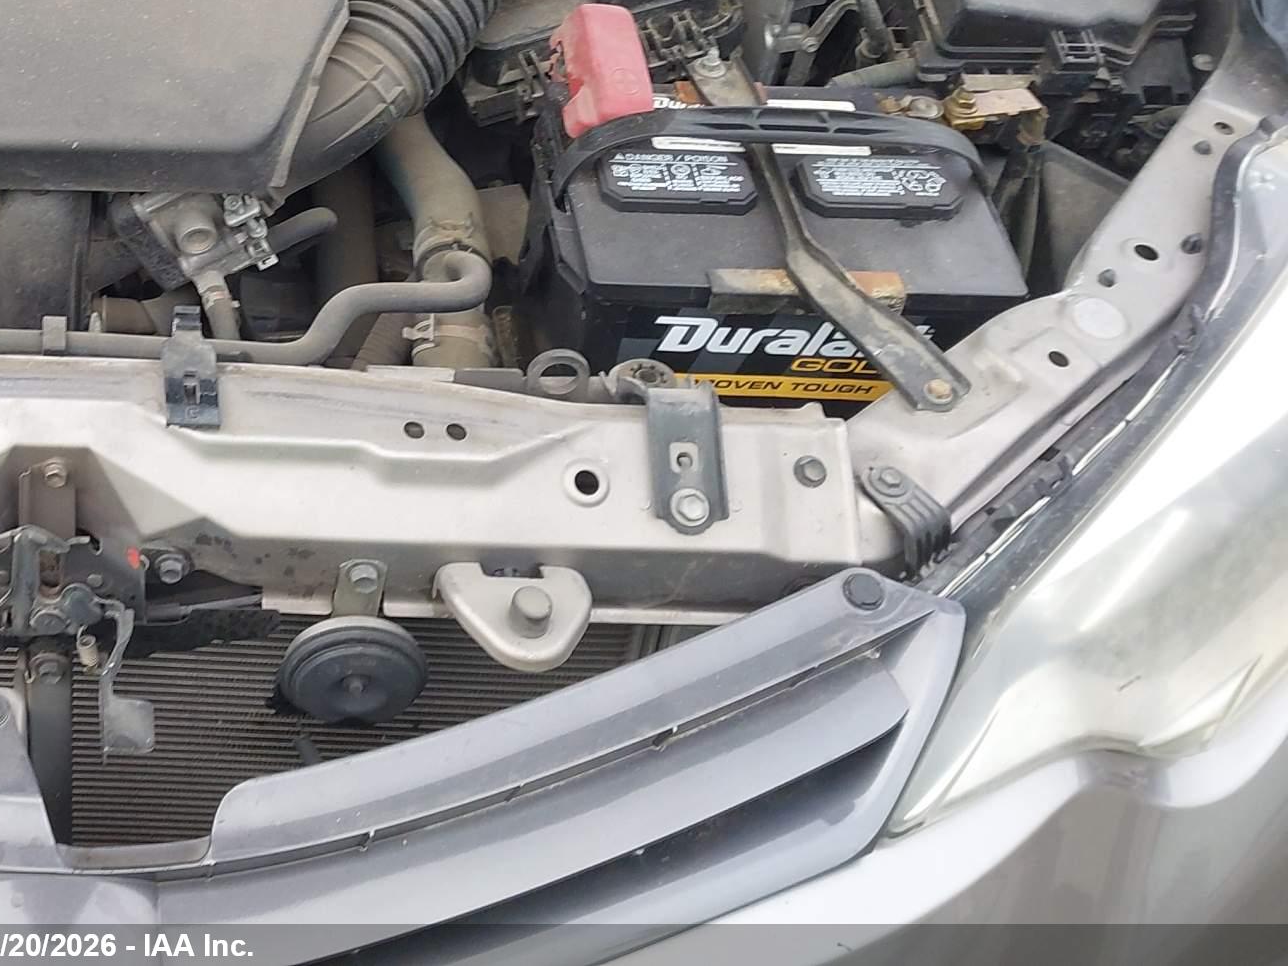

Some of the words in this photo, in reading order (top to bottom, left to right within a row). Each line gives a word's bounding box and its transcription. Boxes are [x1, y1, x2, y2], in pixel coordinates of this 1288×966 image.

[654, 315, 936, 358] Durala
[790, 357, 879, 374] GOL
[694, 379, 784, 391] OVEN
[791, 382, 875, 395] TOUGH
